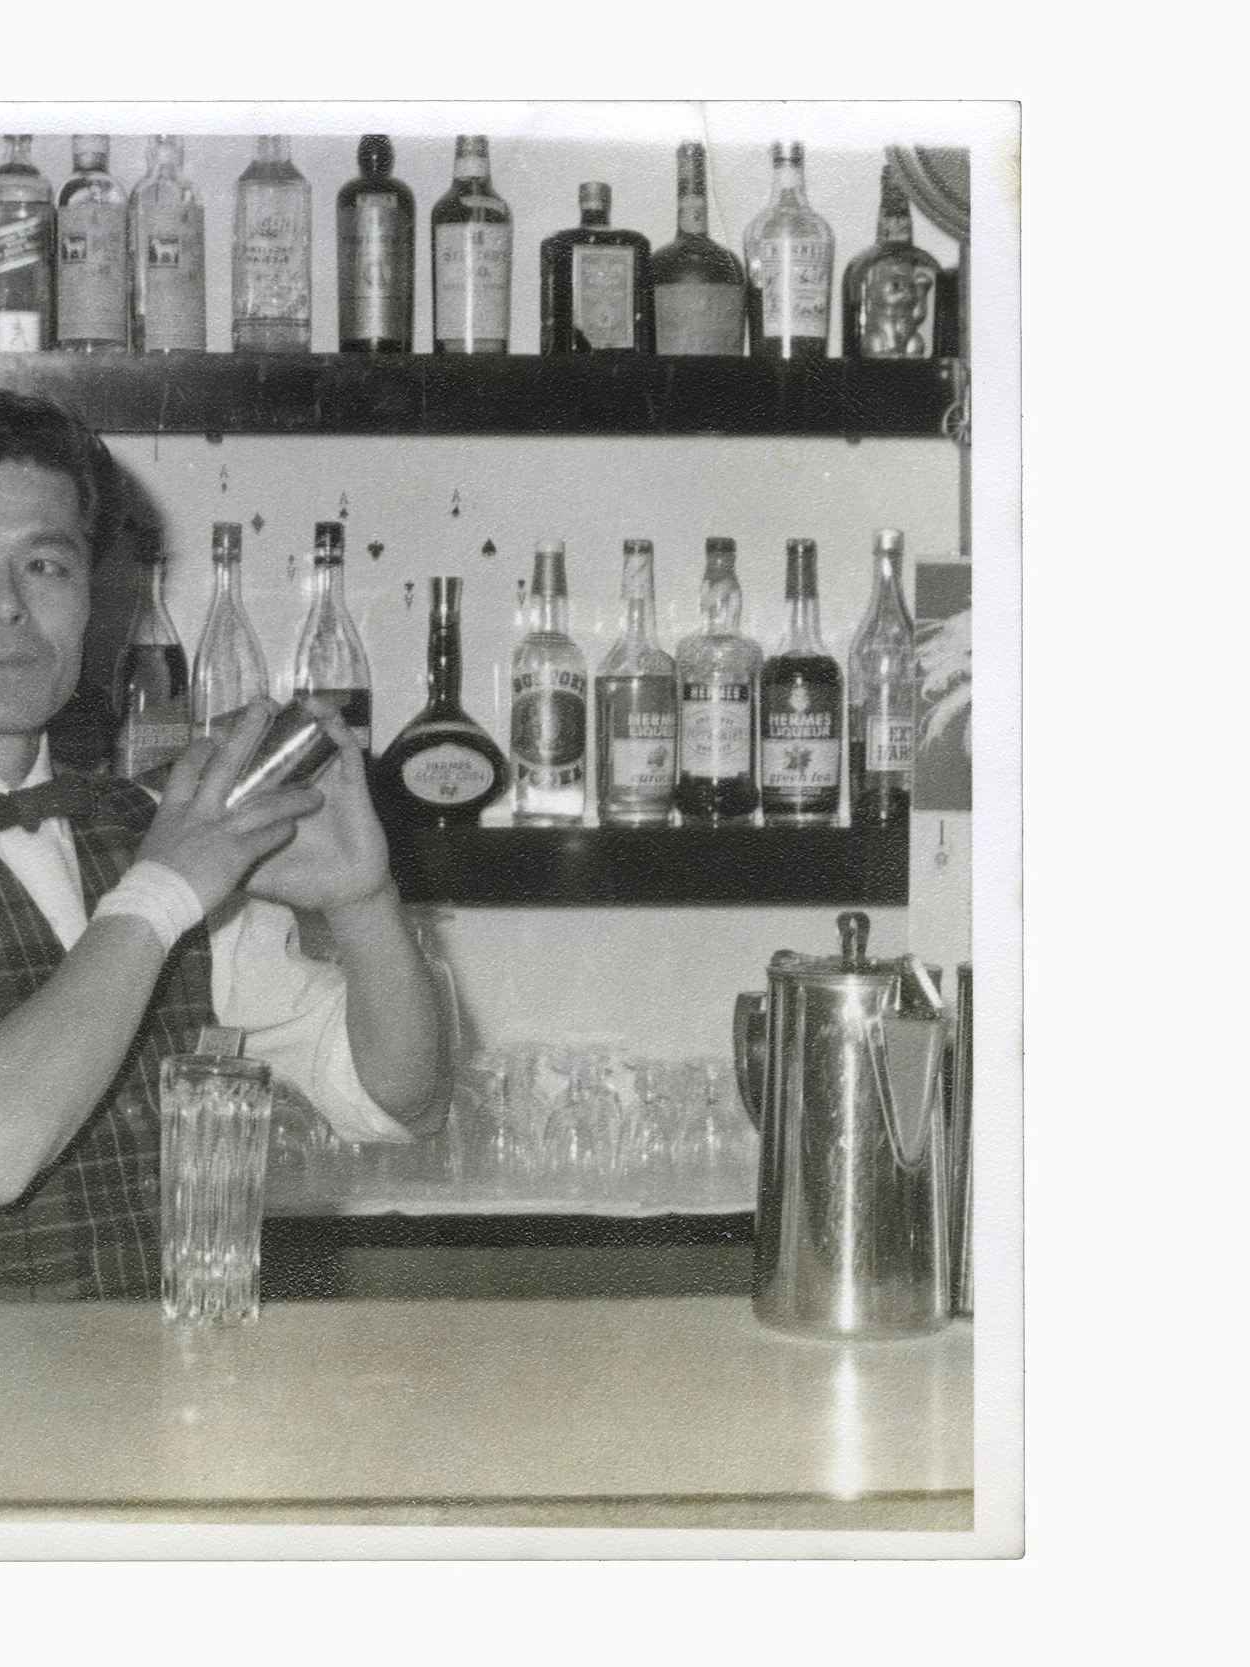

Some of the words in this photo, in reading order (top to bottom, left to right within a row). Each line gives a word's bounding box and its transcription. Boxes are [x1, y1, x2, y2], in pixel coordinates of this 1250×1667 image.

[452, 488, 462, 502] A
[769, 713, 832, 725] HERMES
[769, 726, 831, 737] LIQUEUR
[426, 761, 472, 769] HERMES
[810, 771, 832, 783] tea
